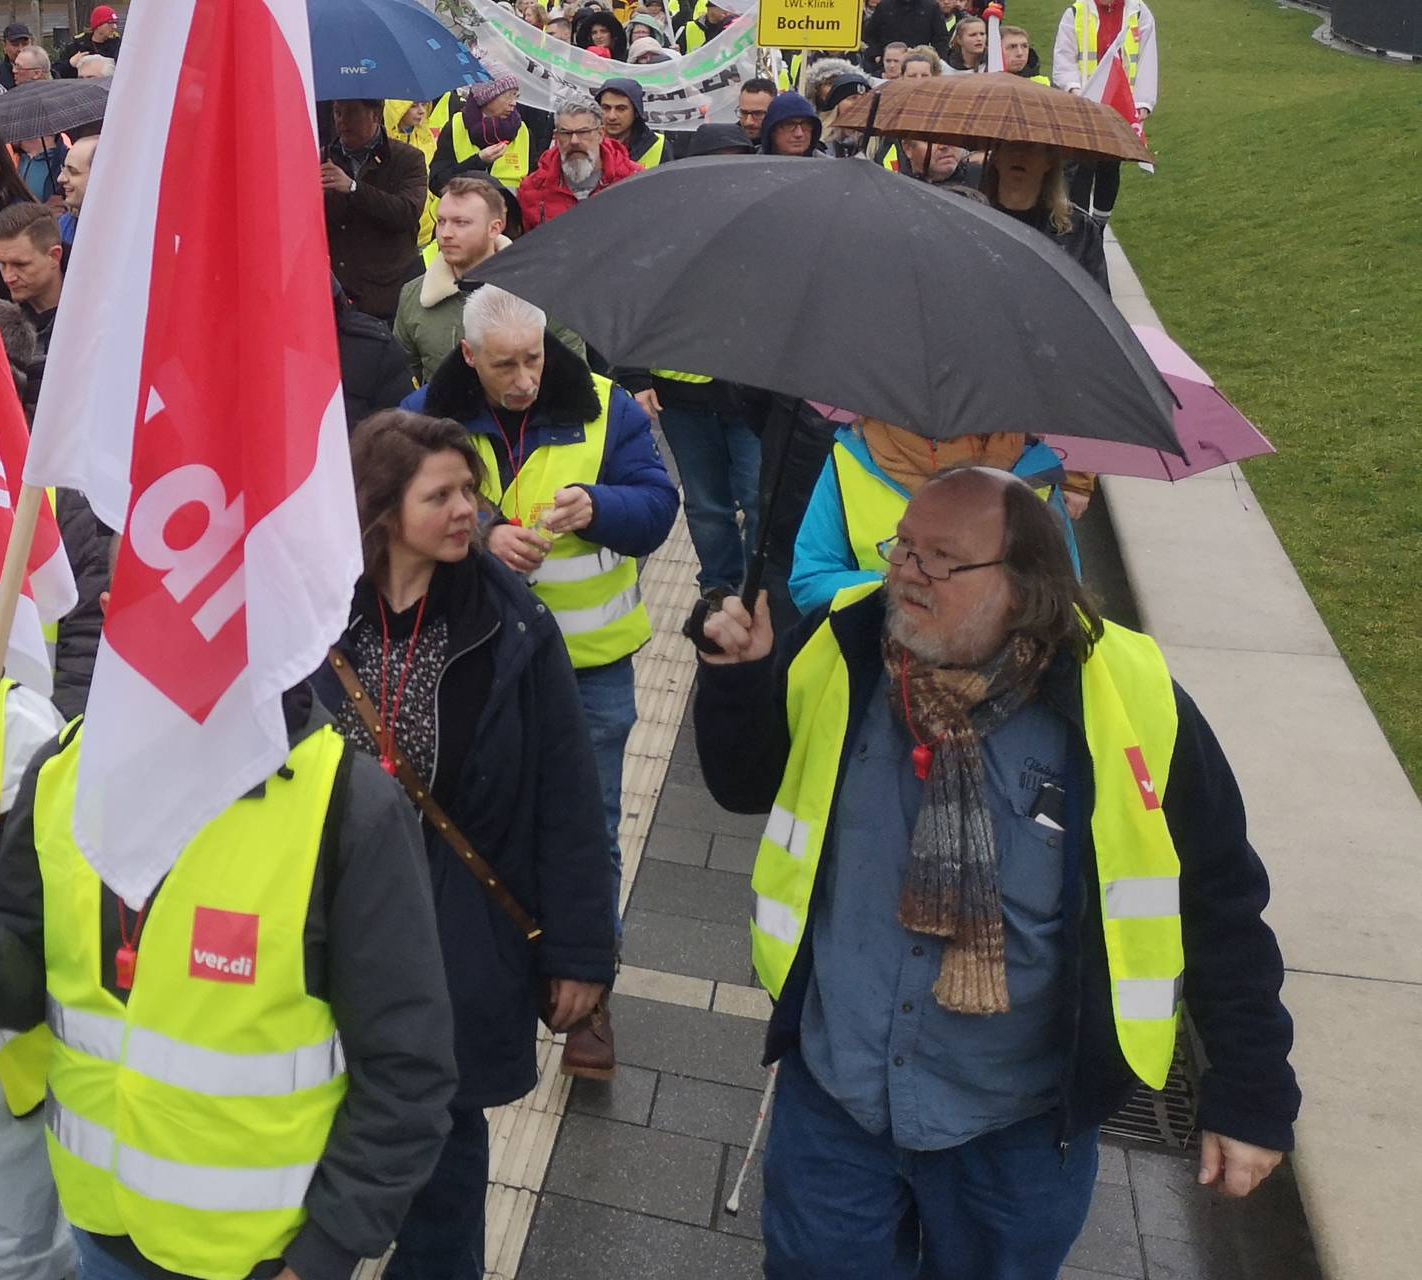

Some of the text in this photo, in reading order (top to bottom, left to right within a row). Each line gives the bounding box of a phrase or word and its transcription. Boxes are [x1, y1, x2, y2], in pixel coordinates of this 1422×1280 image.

[777, 15, 841, 30] Bochum
[340, 66, 369, 75] RWE
[193, 947, 253, 977] ver.di
